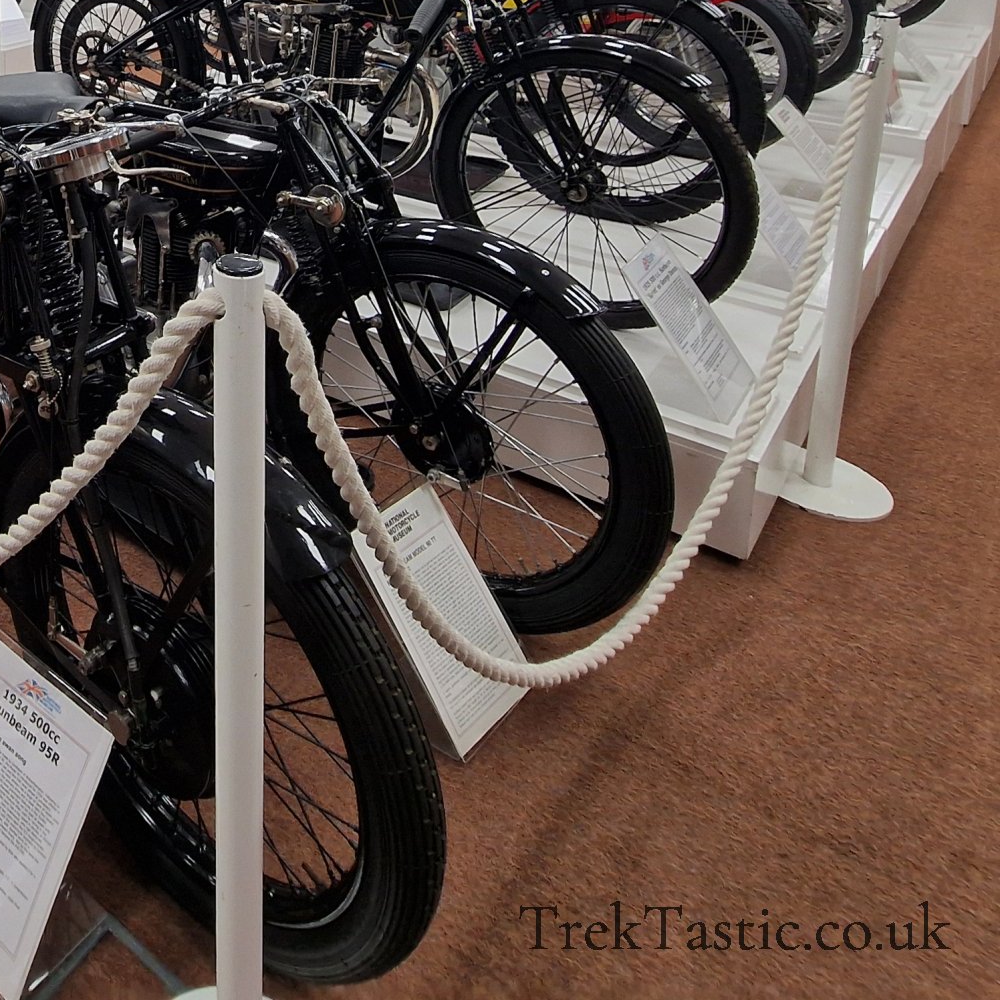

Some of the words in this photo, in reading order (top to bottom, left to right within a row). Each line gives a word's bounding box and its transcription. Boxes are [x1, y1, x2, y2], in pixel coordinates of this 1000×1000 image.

[384, 508, 410, 528] NATIONAL
[387, 510, 420, 536] MOTORCYCLE
[2, 689, 29, 715] 1934
[29, 711, 61, 745] 500cc
[1, 740, 15, 754] swan
[14, 752, 27, 766] song
[38, 741, 60, 767] 95R
